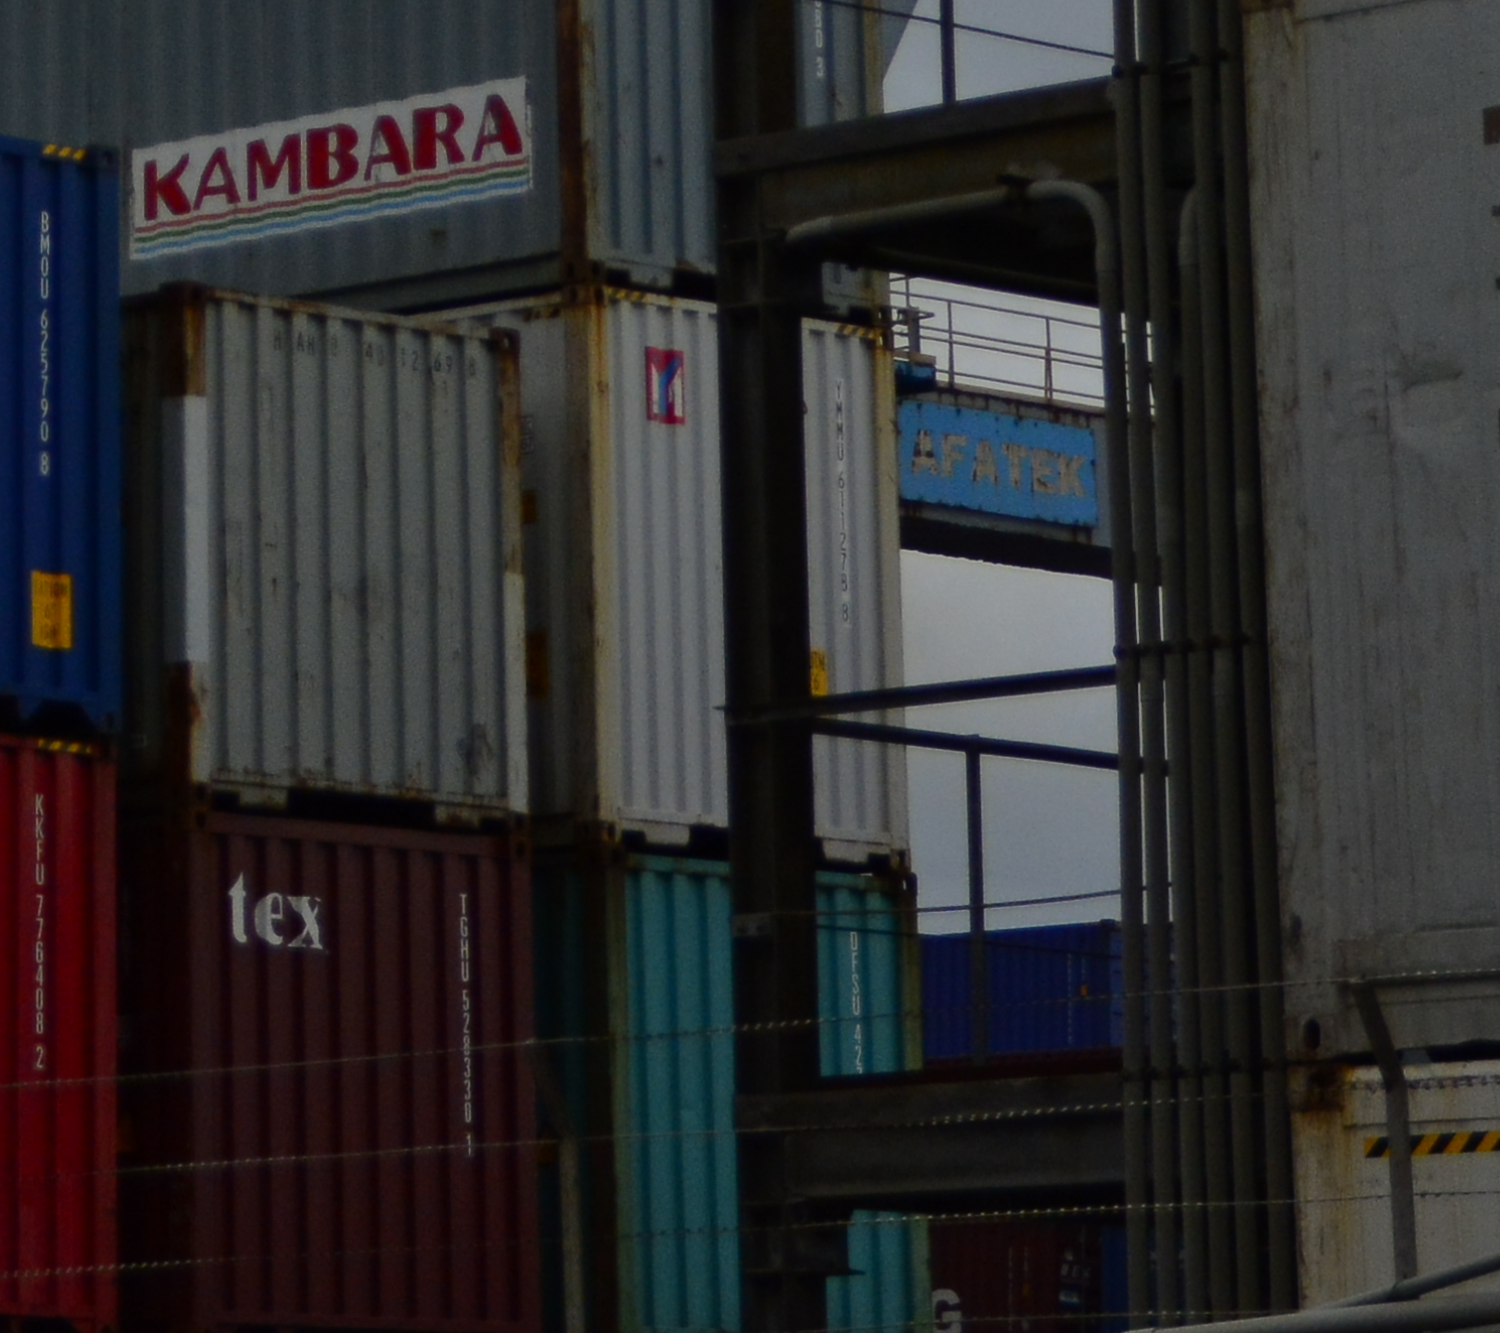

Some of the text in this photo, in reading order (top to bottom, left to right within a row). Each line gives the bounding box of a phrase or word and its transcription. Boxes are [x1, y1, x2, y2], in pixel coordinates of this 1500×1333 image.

[143, 93, 524, 221] KAMBARA
[39, 211, 51, 300] BMOU
[39, 308, 50, 443] 625790
[911, 428, 1086, 497] AFATEK
[35, 793, 46, 886] KKFU
[227, 871, 323, 950] tex
[459, 893, 470, 982] TGHU
[35, 894, 45, 1035] 776408
